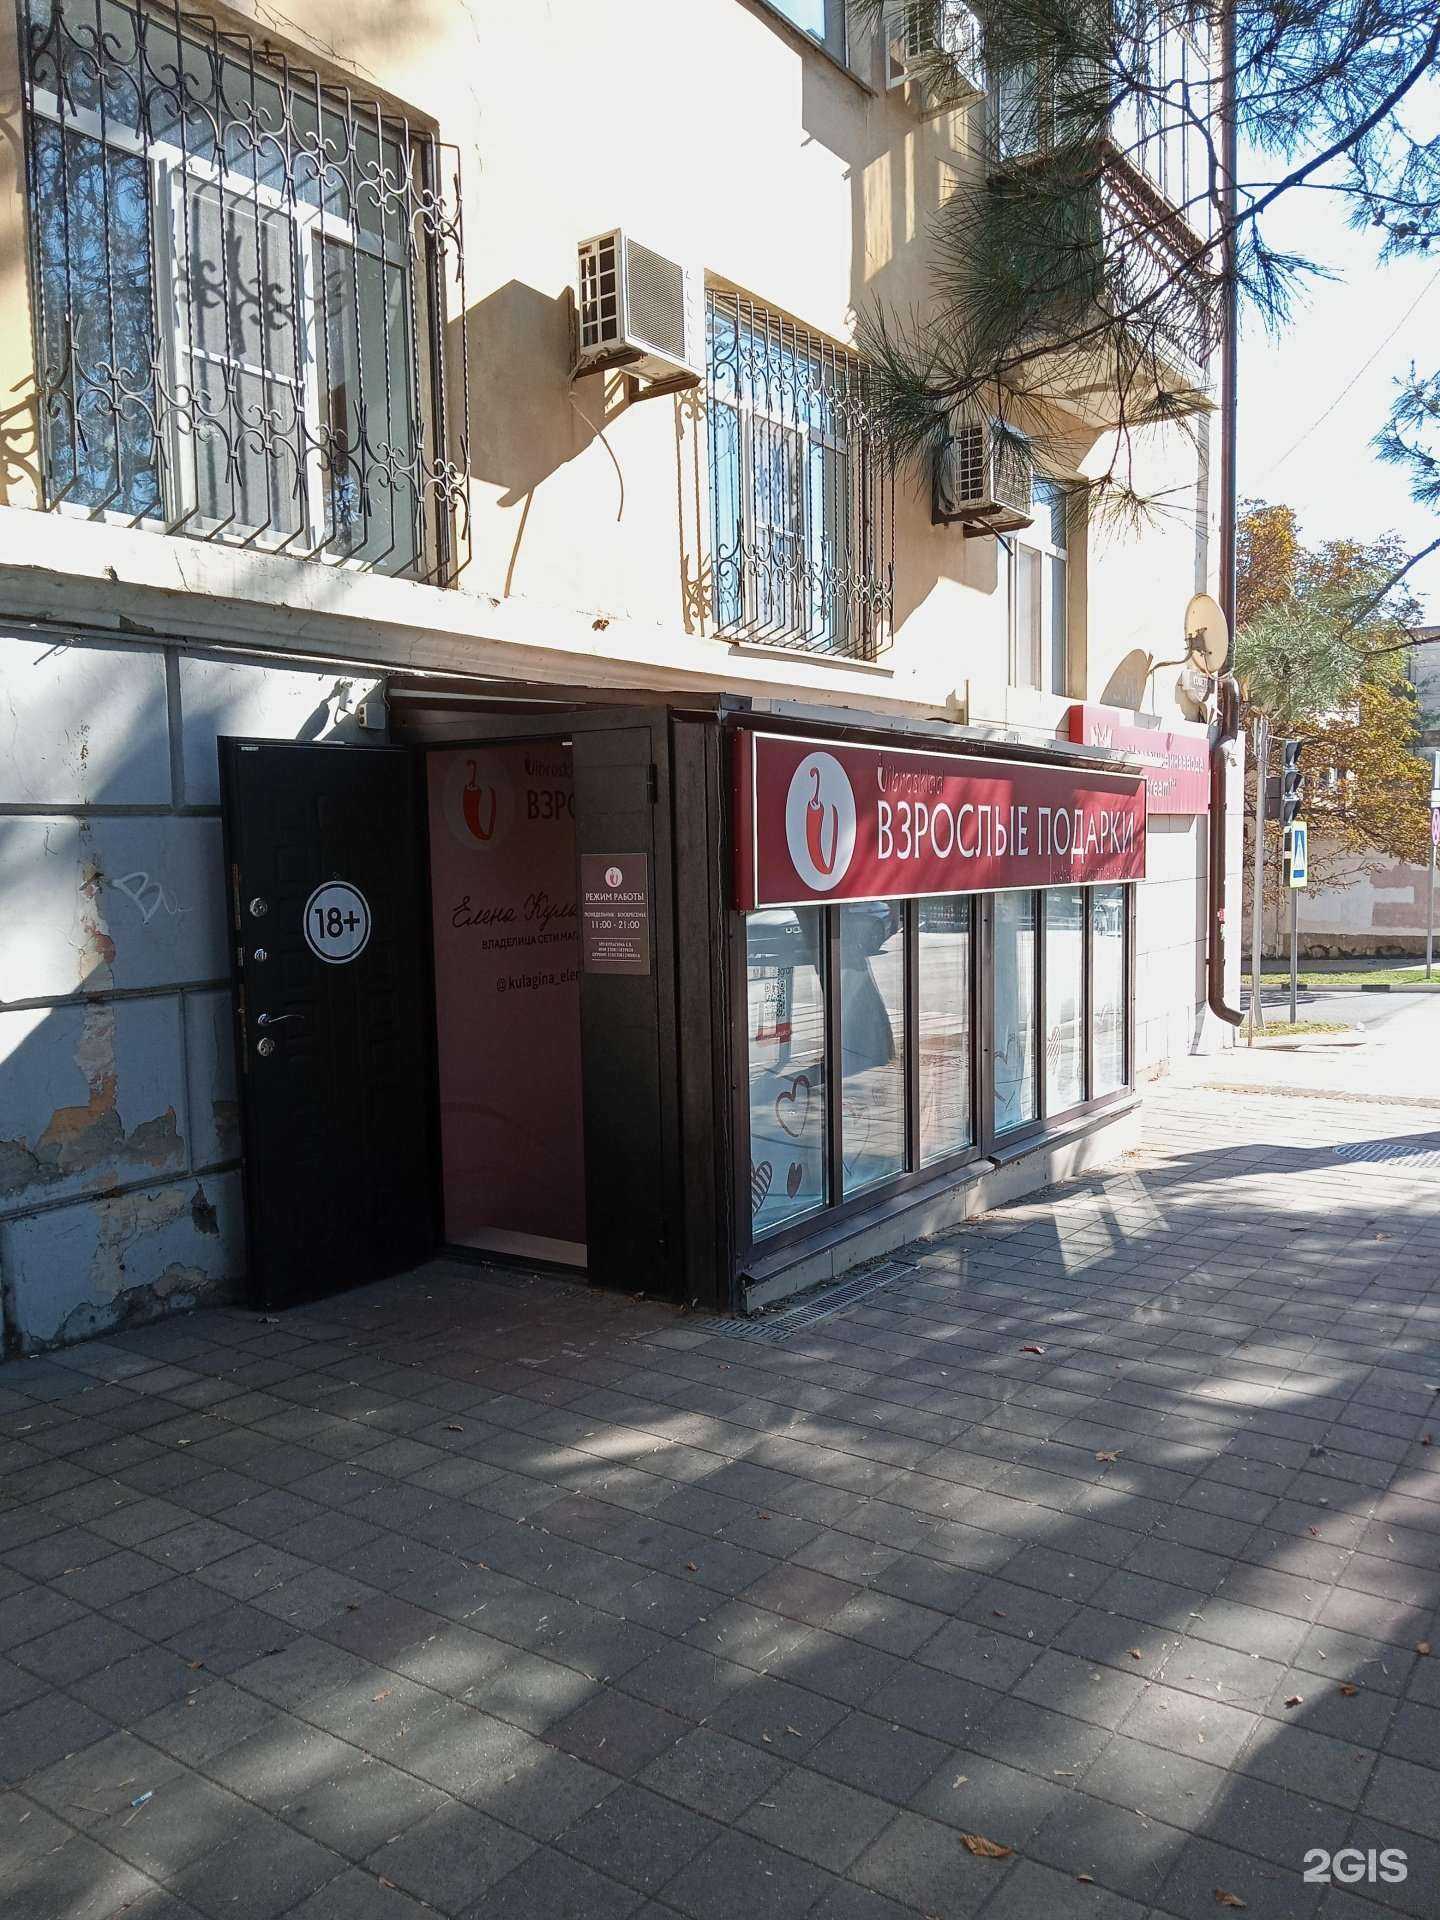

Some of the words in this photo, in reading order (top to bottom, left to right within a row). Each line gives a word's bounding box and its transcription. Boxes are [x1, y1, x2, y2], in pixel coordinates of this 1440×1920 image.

[876, 801, 1029, 860] ВЗРОСЛЫЕ
[1037, 806, 1135, 866] ПОДАРКИ
[585, 892, 612, 901] РЕЖИМ
[613, 892, 644, 901] РАБОТЫ
[314, 907, 360, 938] 18+
[452, 896, 517, 928] Елена
[591, 920, 612, 929] 11:00
[618, 920, 640, 929] 21:00
[481, 935, 536, 950] ВЛАДЕЛИЦА
[537, 933, 560, 945] СЕТИ
